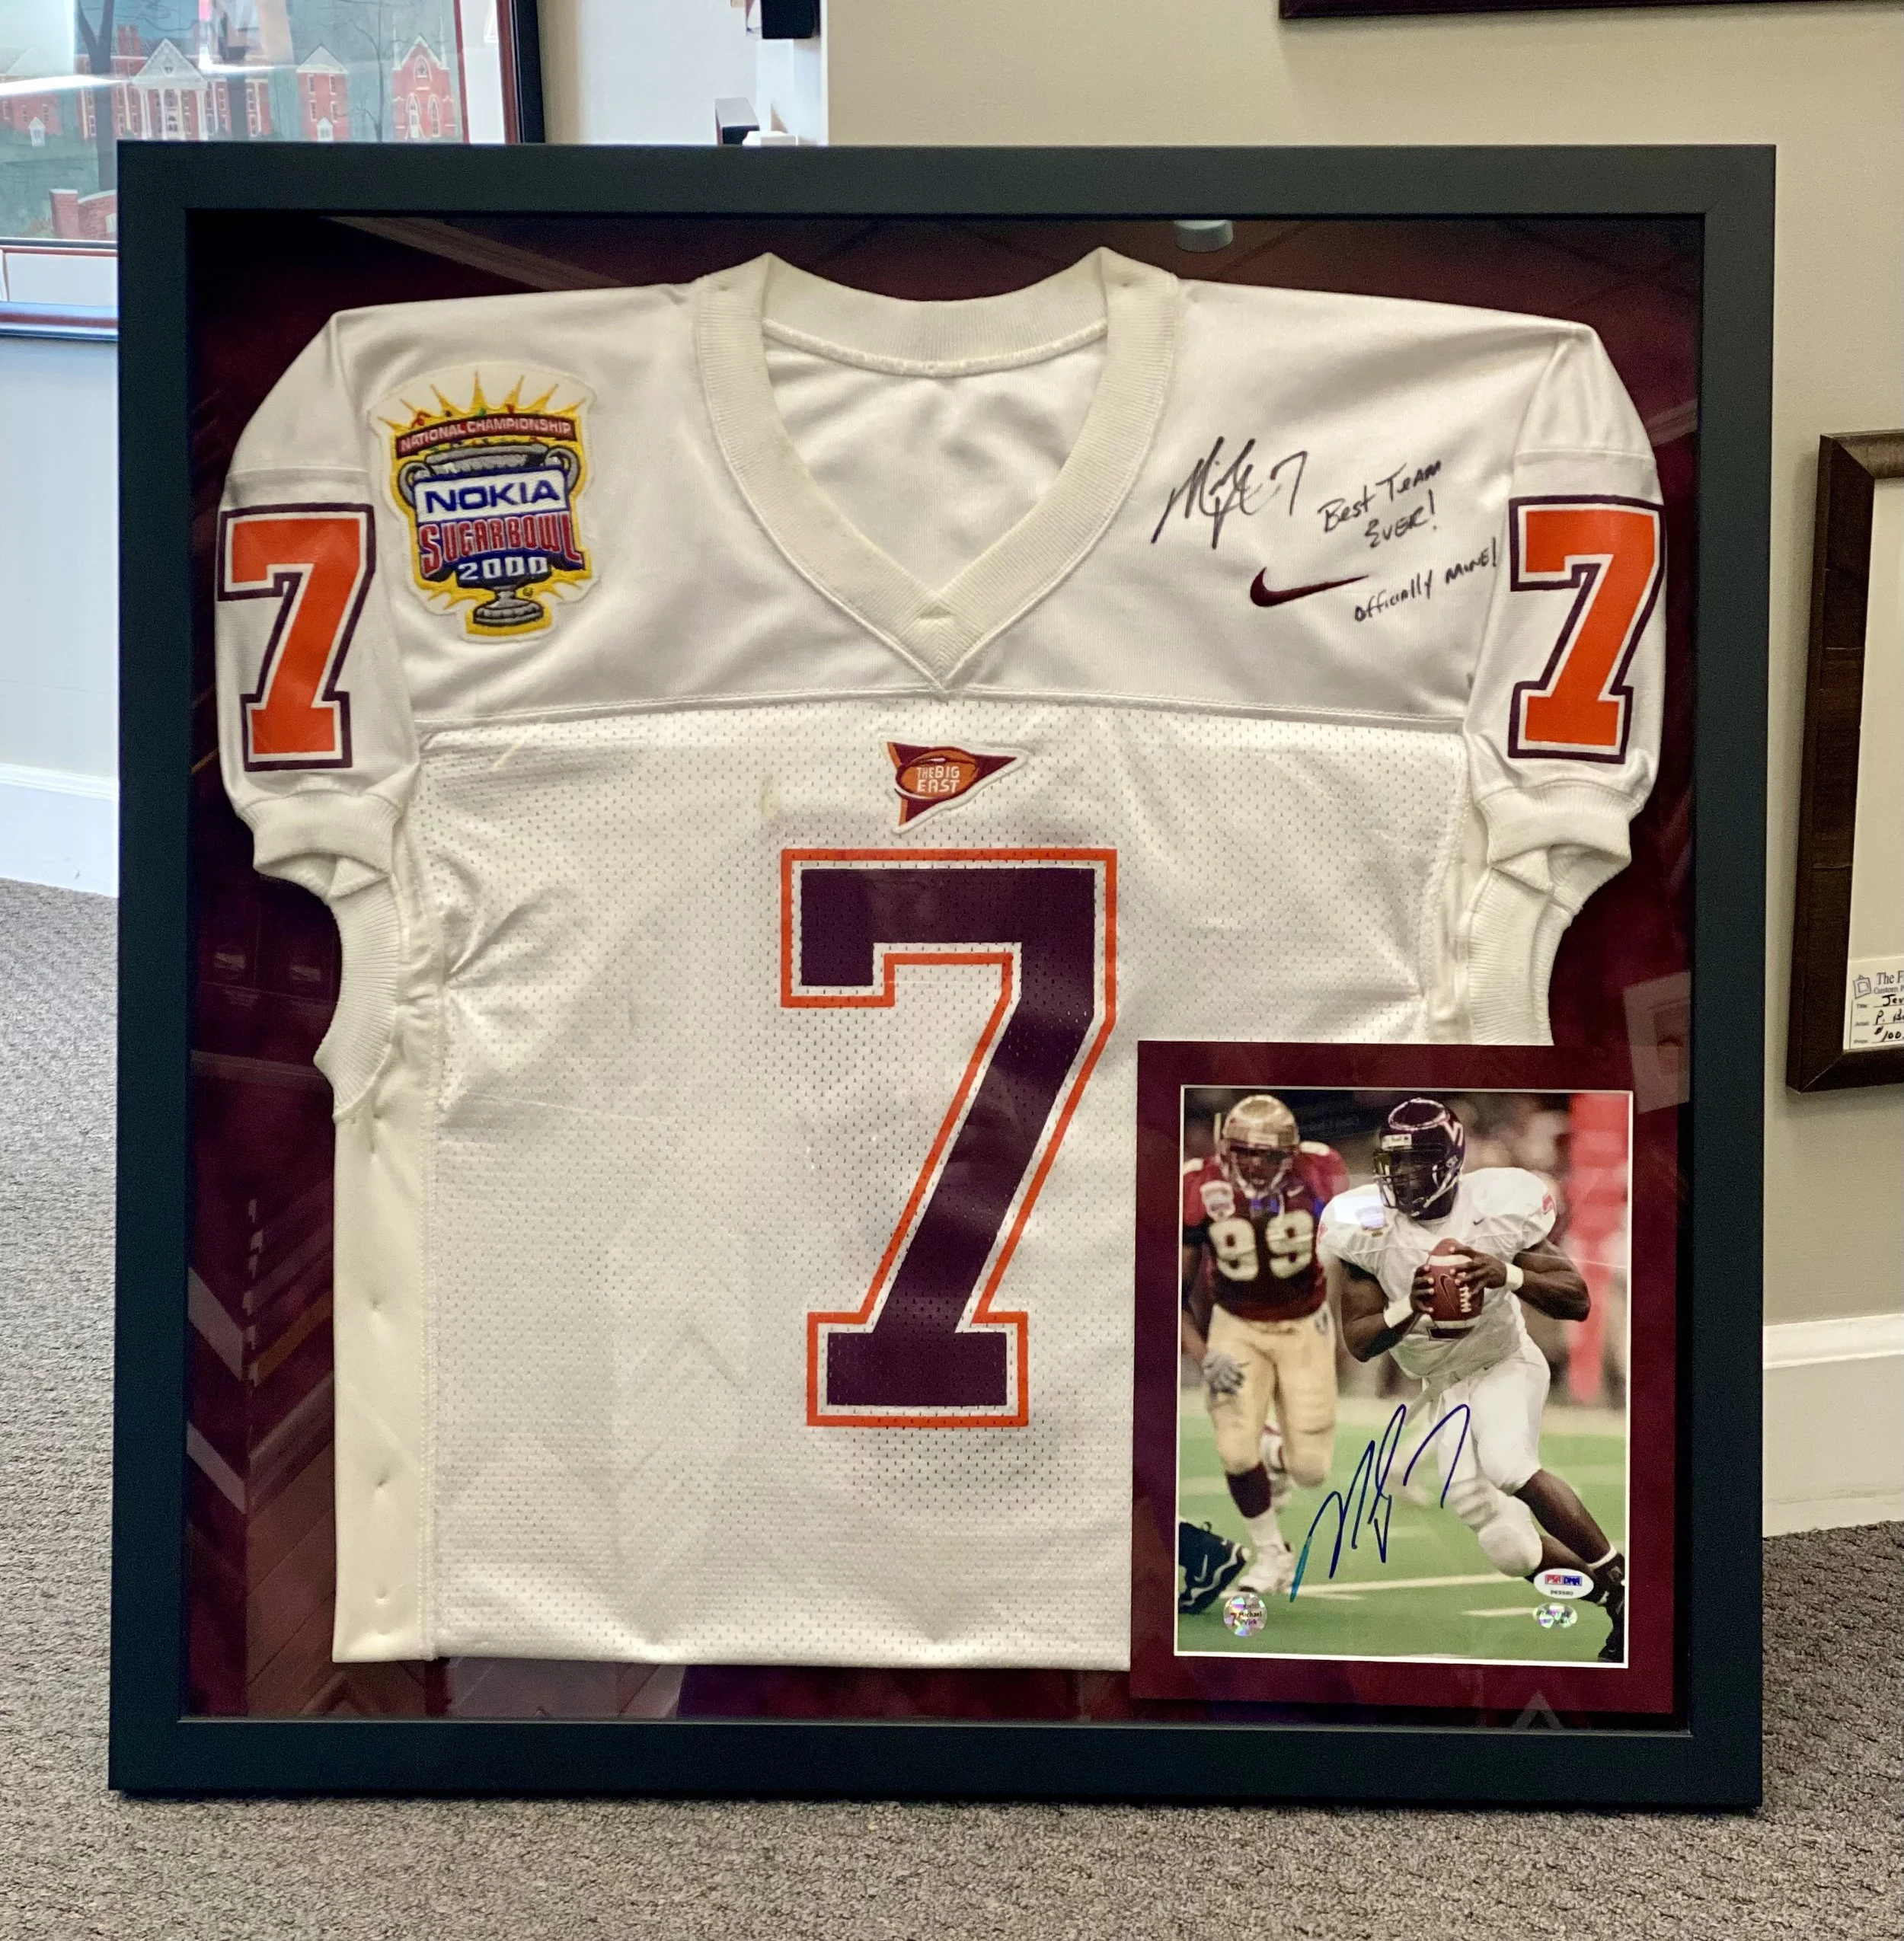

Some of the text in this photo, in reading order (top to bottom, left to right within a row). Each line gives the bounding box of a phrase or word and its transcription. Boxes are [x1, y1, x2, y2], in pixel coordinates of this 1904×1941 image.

[399, 417, 572, 453] NATIONAL CHAMPIONSHIP
[424, 479, 561, 514] NOKIA
[1317, 484, 1377, 533] Best
[458, 556, 548, 581] 2000
[217, 502, 376, 772] 7
[1507, 494, 1667, 765] 7
[916, 765, 960, 779] THE BIG
[916, 778, 960, 793] EAST
[1877, 971, 1895, 985] The
[781, 848, 1118, 1427] 7
[1209, 1209, 1314, 1282] 99
